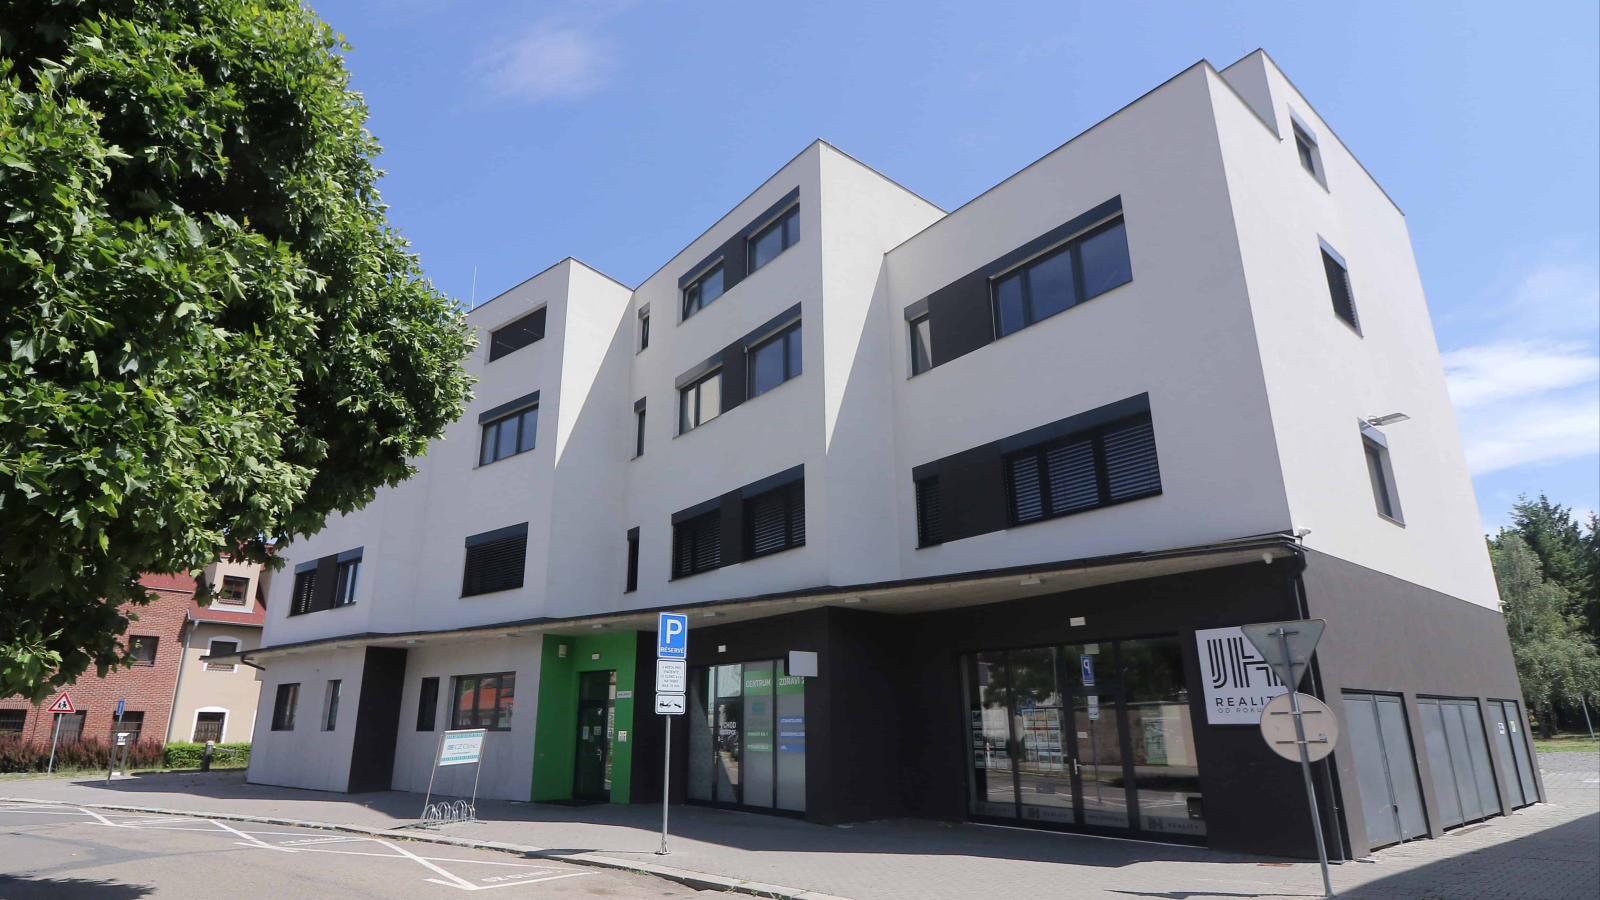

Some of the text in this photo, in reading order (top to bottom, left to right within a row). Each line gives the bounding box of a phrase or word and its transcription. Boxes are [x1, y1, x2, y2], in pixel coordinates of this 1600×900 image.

[666, 619, 682, 644] P
[660, 646, 684, 654] RÉSERVÉ
[745, 678, 771, 688] CENTRUM
